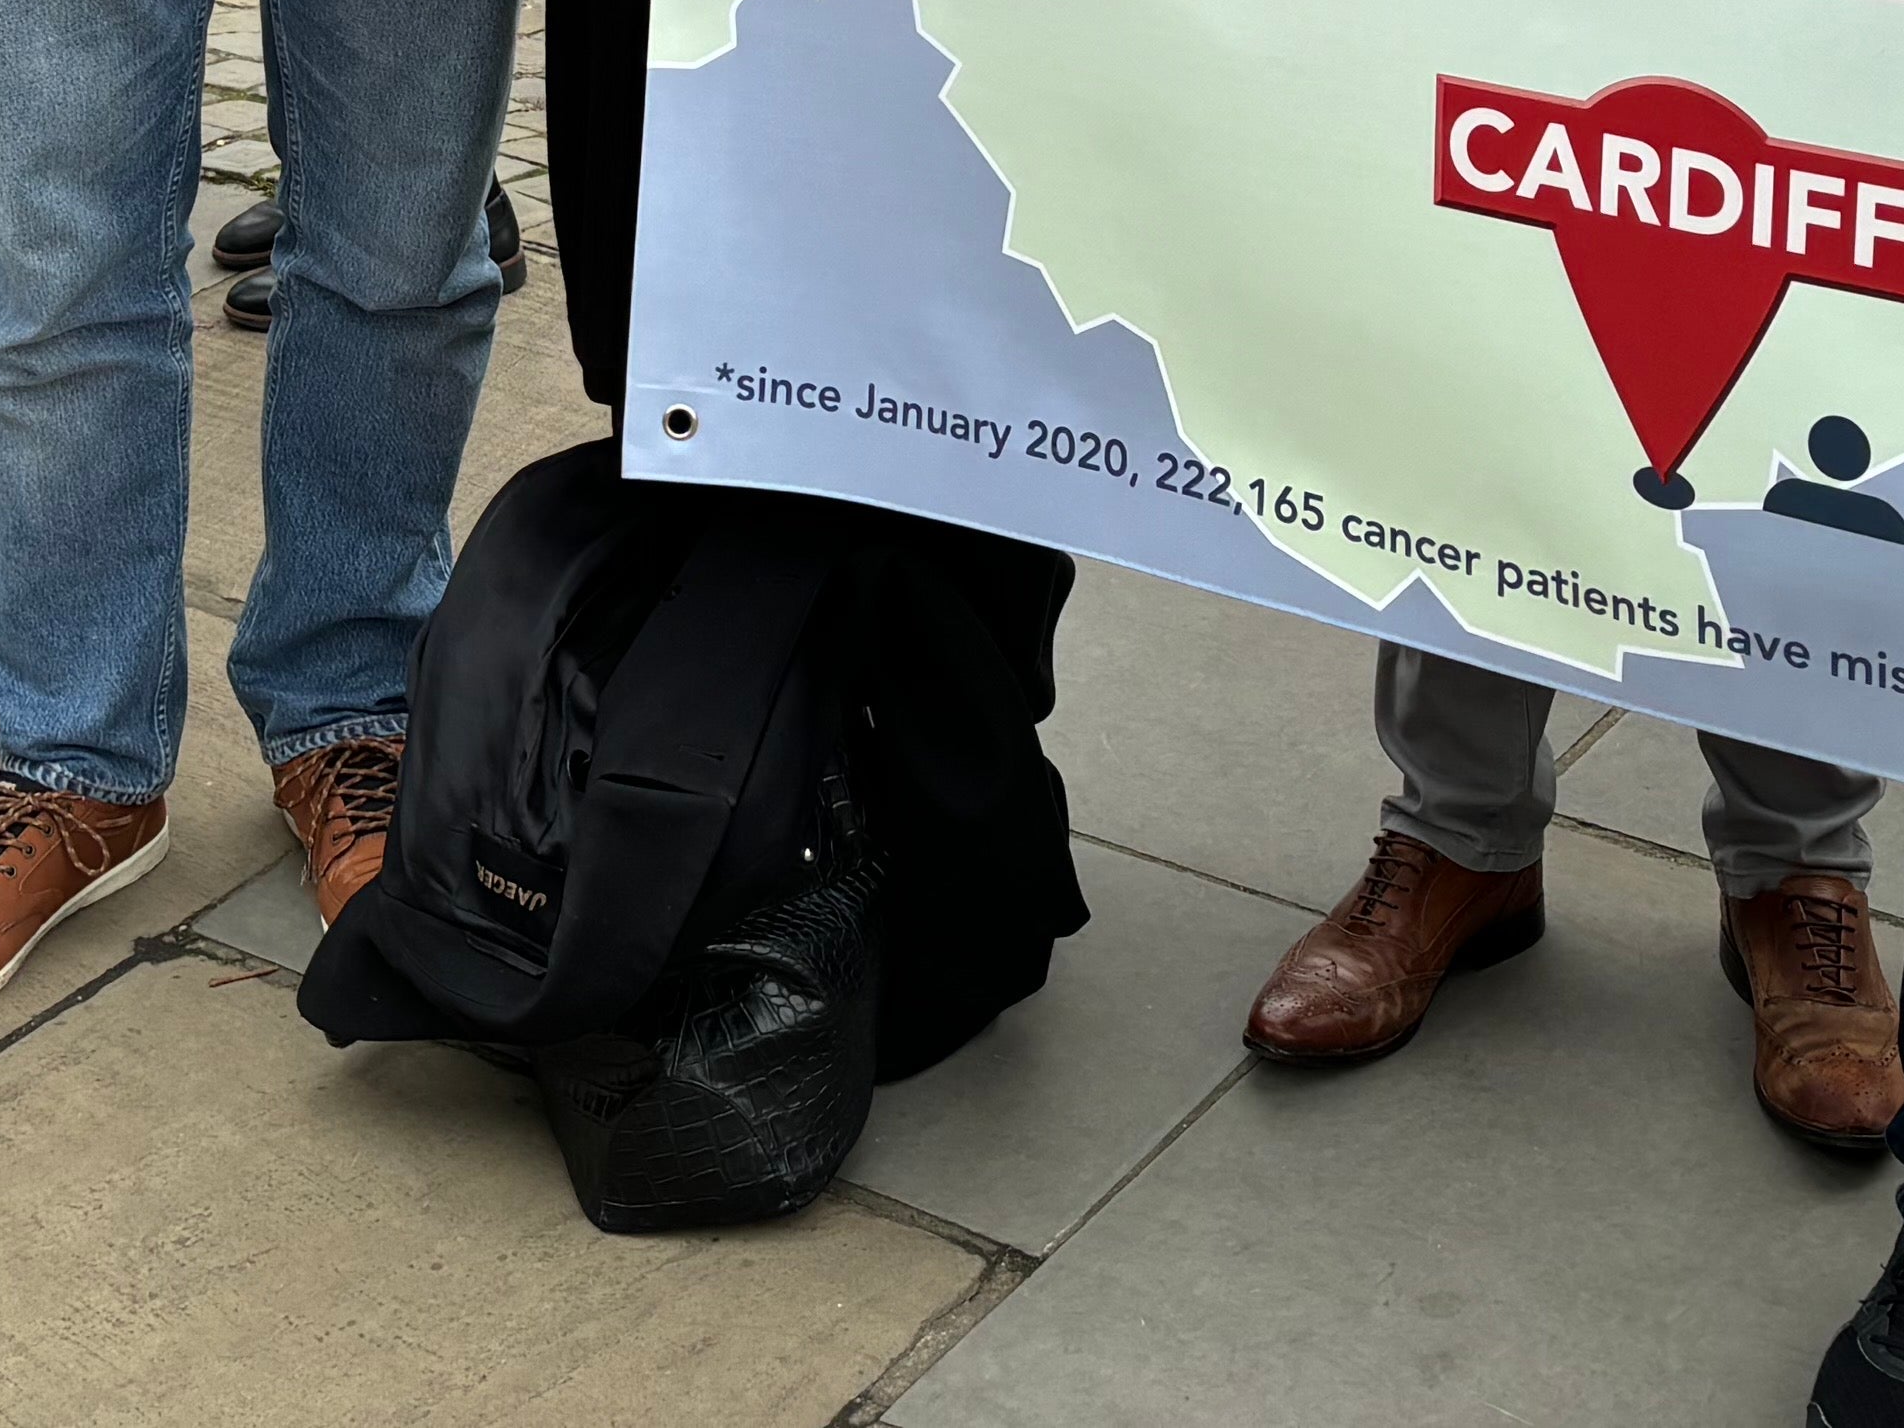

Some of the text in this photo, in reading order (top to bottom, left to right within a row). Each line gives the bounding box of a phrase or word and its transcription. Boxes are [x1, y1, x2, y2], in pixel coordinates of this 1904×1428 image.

[855, 383, 1012, 459] January
[1025, 419, 1139, 488] 2020,
[1155, 452, 1325, 531] 222,165
[1341, 513, 1482, 576] cancer
[1496, 555, 1680, 638] patients
[1697, 605, 1811, 669] have
[476, 859, 548, 912] JAEGER
